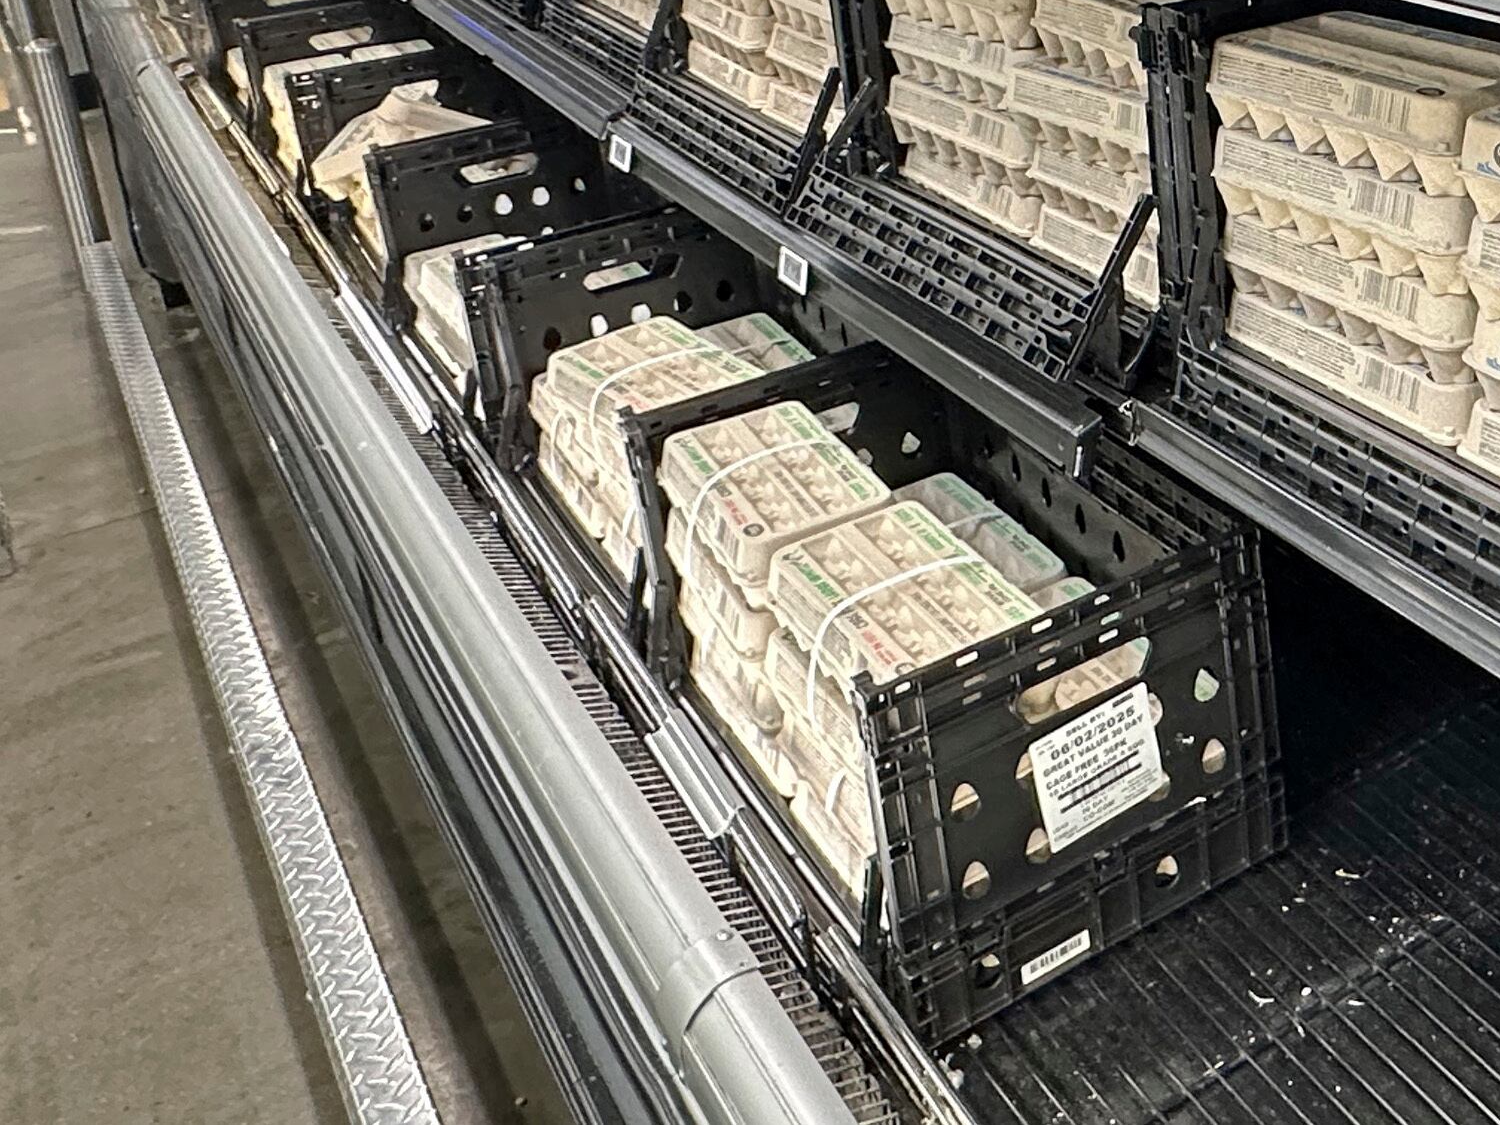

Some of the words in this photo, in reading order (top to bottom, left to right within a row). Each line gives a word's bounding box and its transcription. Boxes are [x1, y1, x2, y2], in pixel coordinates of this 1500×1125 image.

[1049, 706, 1135, 761] 06/02/2025
[1042, 754, 1076, 777] GREAT
[1077, 735, 1109, 758] VALUE
[1045, 770, 1072, 791] CAGE
[1074, 754, 1099, 774] FREE
